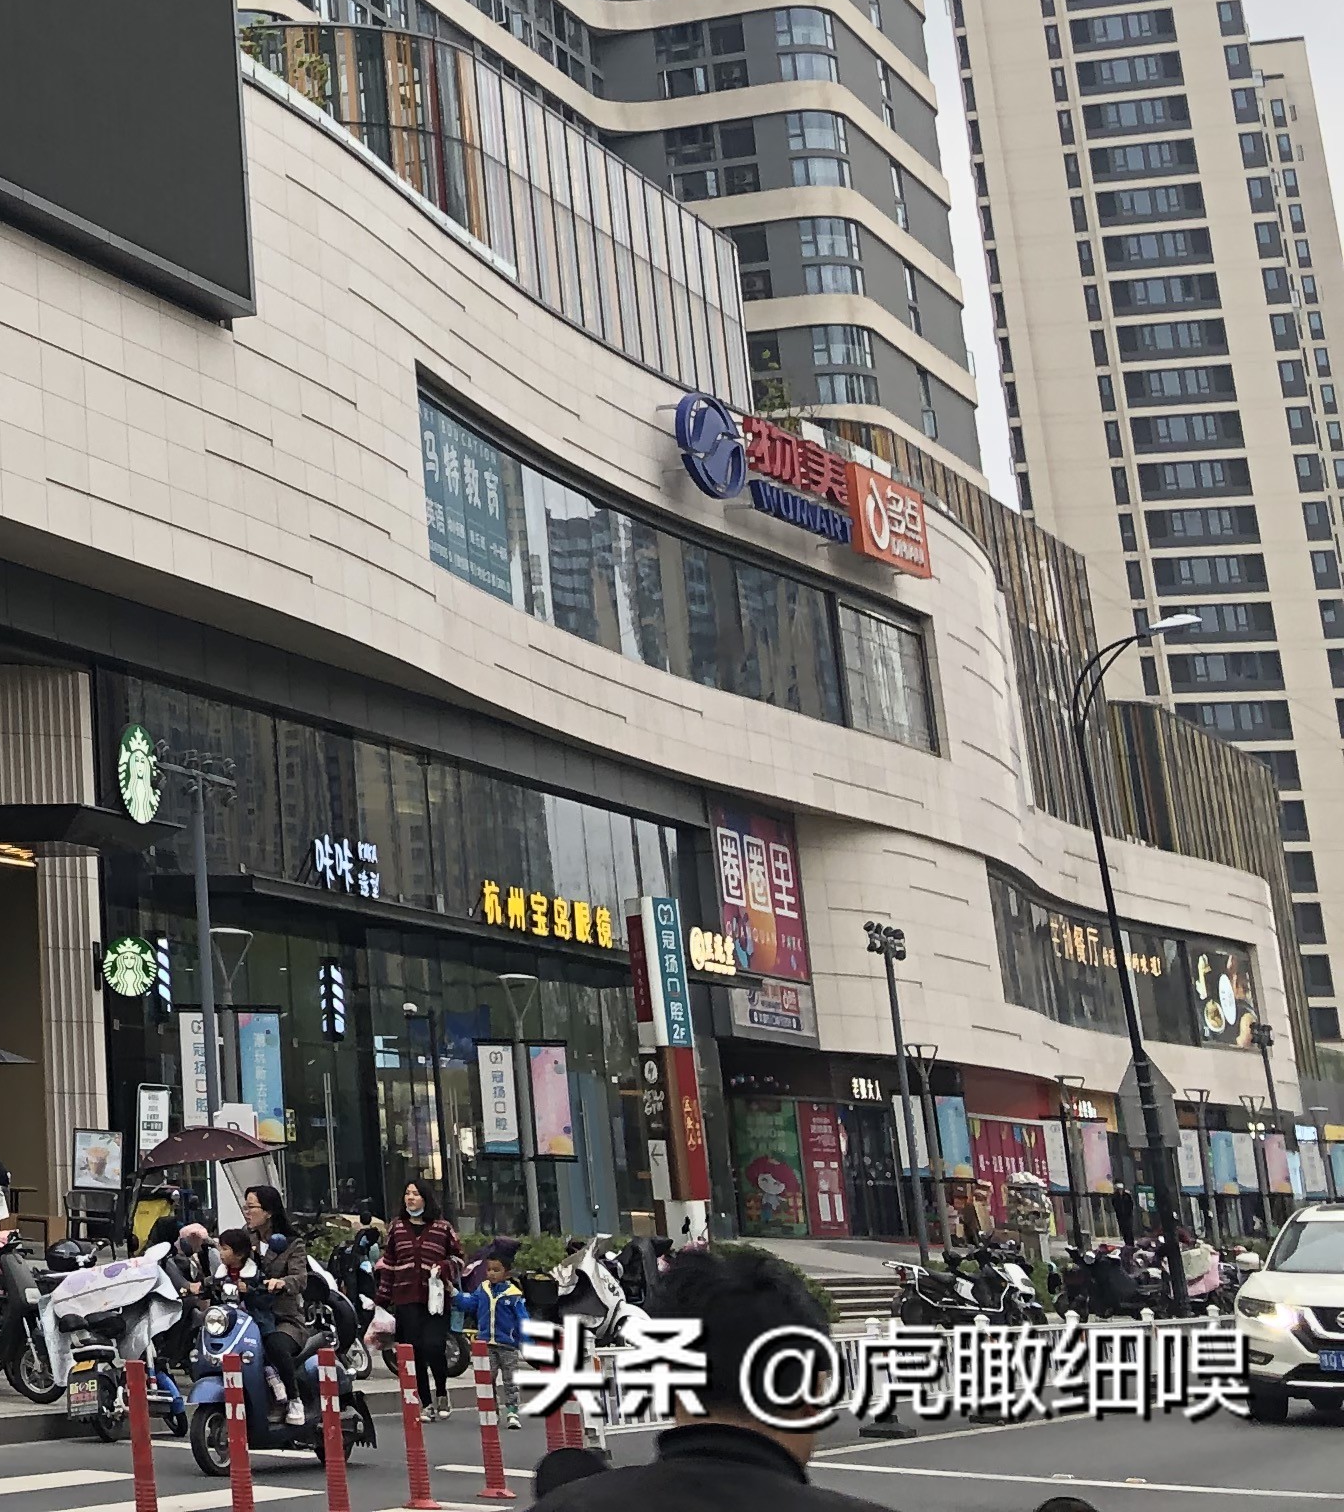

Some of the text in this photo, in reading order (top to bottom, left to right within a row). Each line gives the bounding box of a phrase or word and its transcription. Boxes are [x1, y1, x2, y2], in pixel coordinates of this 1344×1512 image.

[423, 430, 500, 521] 马特教育
[743, 415, 851, 506] 物美
[750, 479, 853, 544] WUMART
[885, 485, 923, 545] 多点
[315, 834, 354, 892] 咔咔
[717, 826, 799, 919] 圈圈里
[483, 880, 612, 949] 杭州宝岛眼镜
[662, 930, 685, 1021] 冠扬口腔
[673, 1024, 686, 1039] 2F
[492, 1070, 508, 1131] 冠扬口腔
